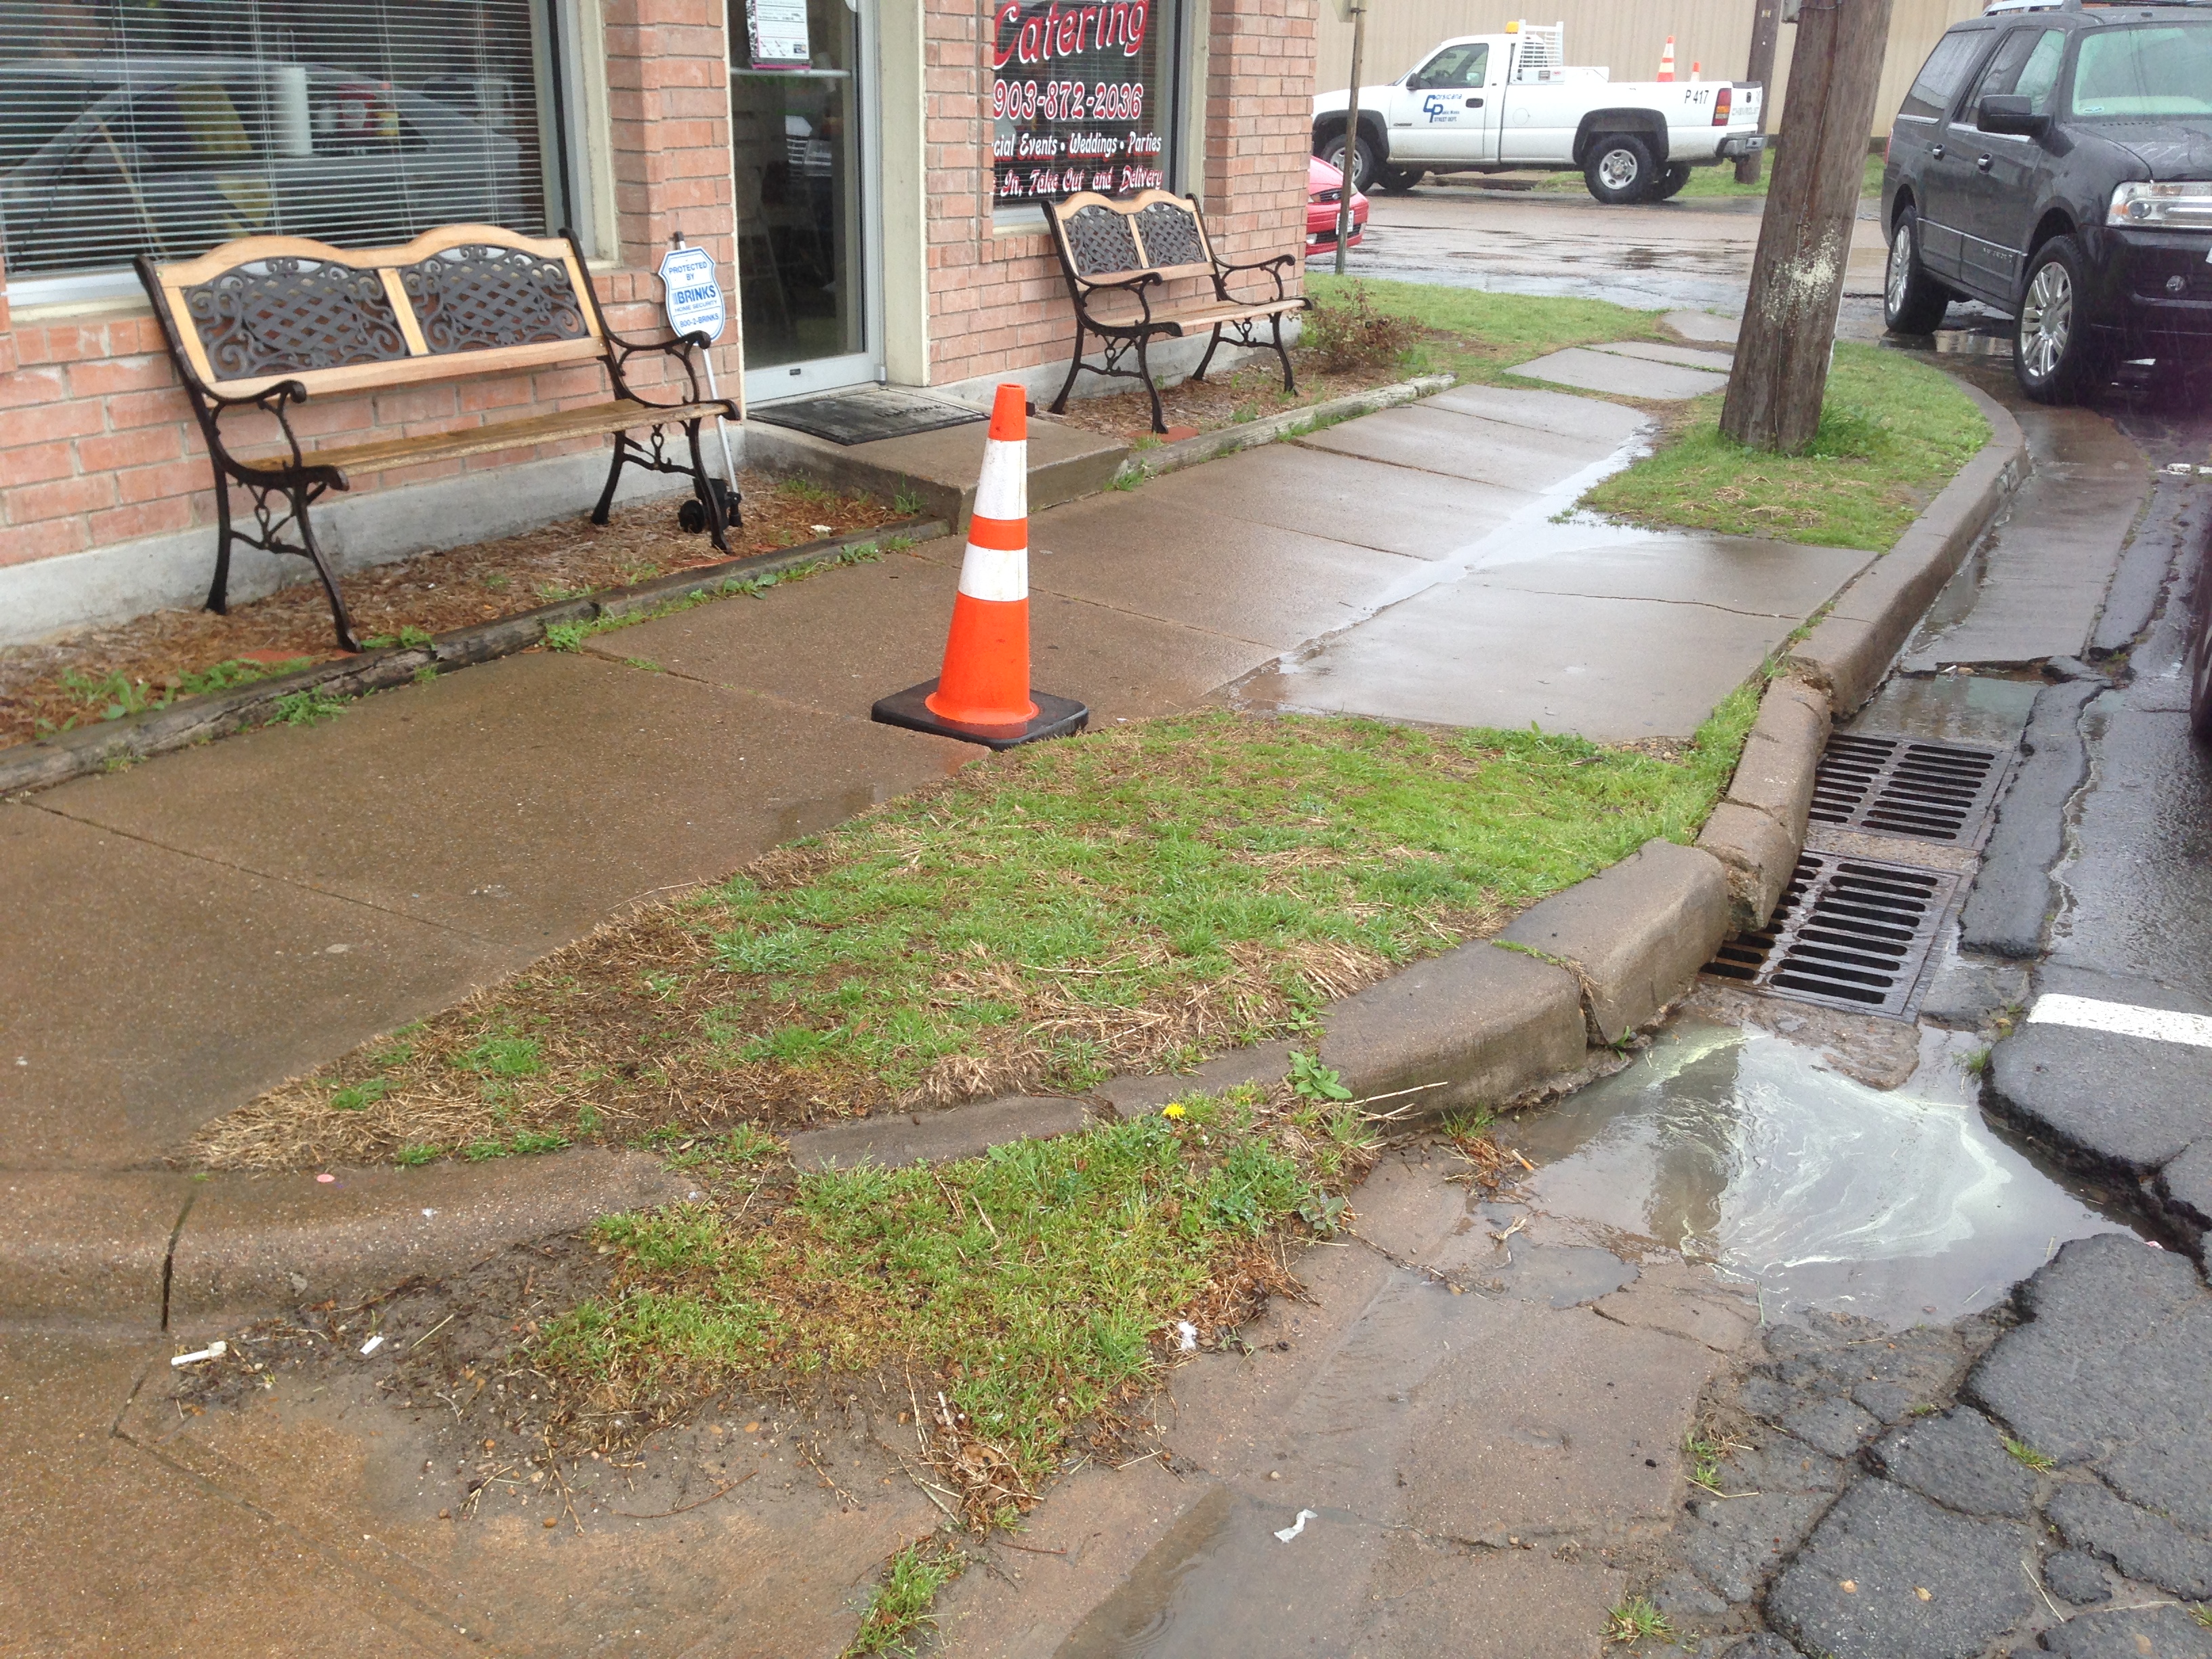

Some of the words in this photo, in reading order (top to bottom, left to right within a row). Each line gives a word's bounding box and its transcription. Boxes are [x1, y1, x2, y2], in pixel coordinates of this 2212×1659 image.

[991, 0, 1150, 70] Catering
[994, 79, 1143, 121] 903-872-2036
[1684, 89, 1692, 104] P
[1693, 89, 1709, 104] 417
[991, 134, 1015, 157] cial
[1019, 133, 1057, 157] Events
[1069, 131, 1118, 158] Weddings
[1128, 131, 1162, 154] Parties
[1028, 169, 1059, 197] Take
[1062, 167, 1084, 192] Out
[1092, 166, 1114, 190] and
[1120, 165, 1164, 192] Delivery
[668, 262, 708, 274] PROTECTED
[678, 285, 716, 304] BRINKS
[675, 304, 691, 312] HOME
[693, 300, 718, 310] SECURITY
[680, 313, 719, 327] 800-2-BRINKS
